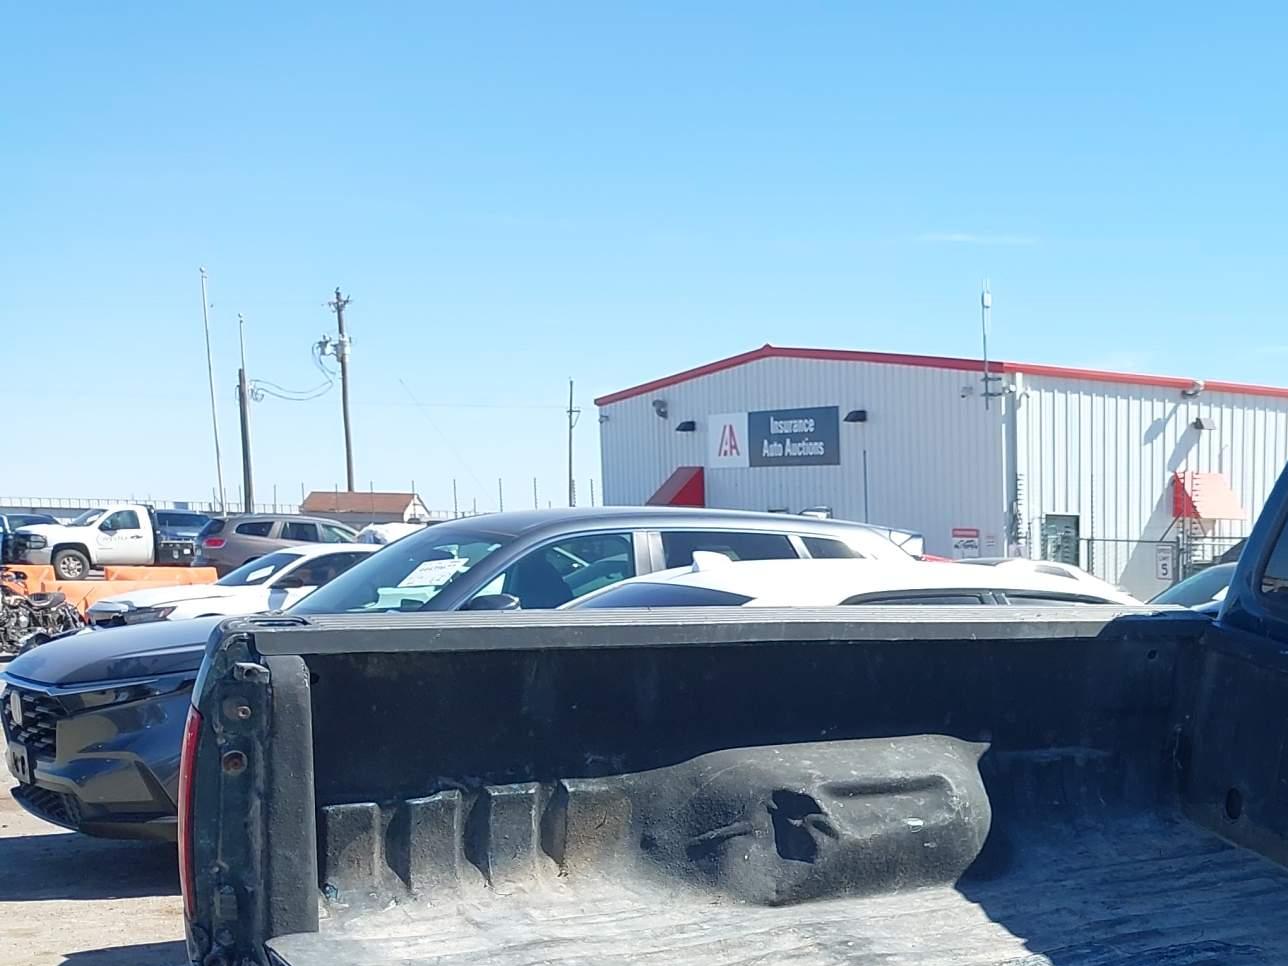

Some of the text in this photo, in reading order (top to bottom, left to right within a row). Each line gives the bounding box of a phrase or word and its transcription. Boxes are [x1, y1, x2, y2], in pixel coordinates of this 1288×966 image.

[770, 416, 815, 434] Insurance
[762, 438, 825, 457] Auto Auctions
